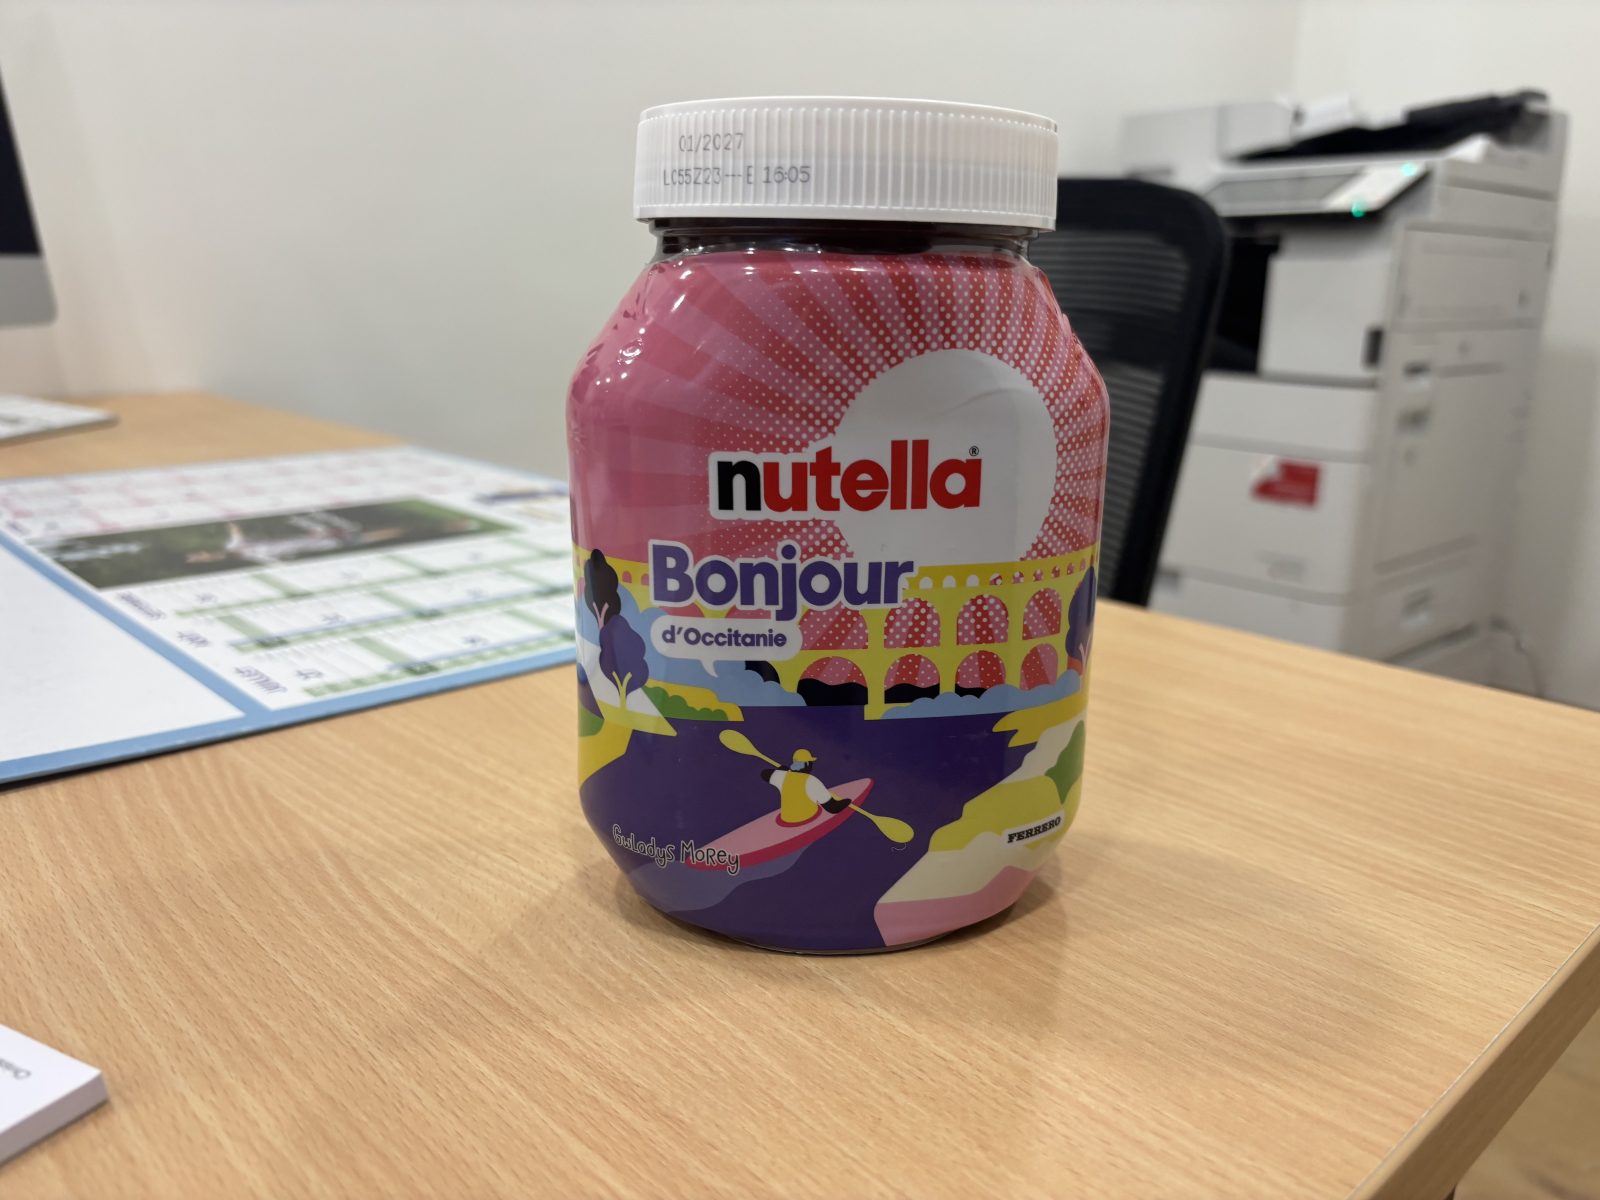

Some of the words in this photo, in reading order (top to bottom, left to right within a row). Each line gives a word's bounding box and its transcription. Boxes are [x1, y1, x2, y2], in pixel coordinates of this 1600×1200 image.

[679, 132, 744, 153] 01/2027
[762, 165, 811, 184] 16:05
[652, 544, 914, 622] Bonjour
[661, 625, 787, 648] d'Occitanie
[1007, 816, 1062, 843] FERRERO
